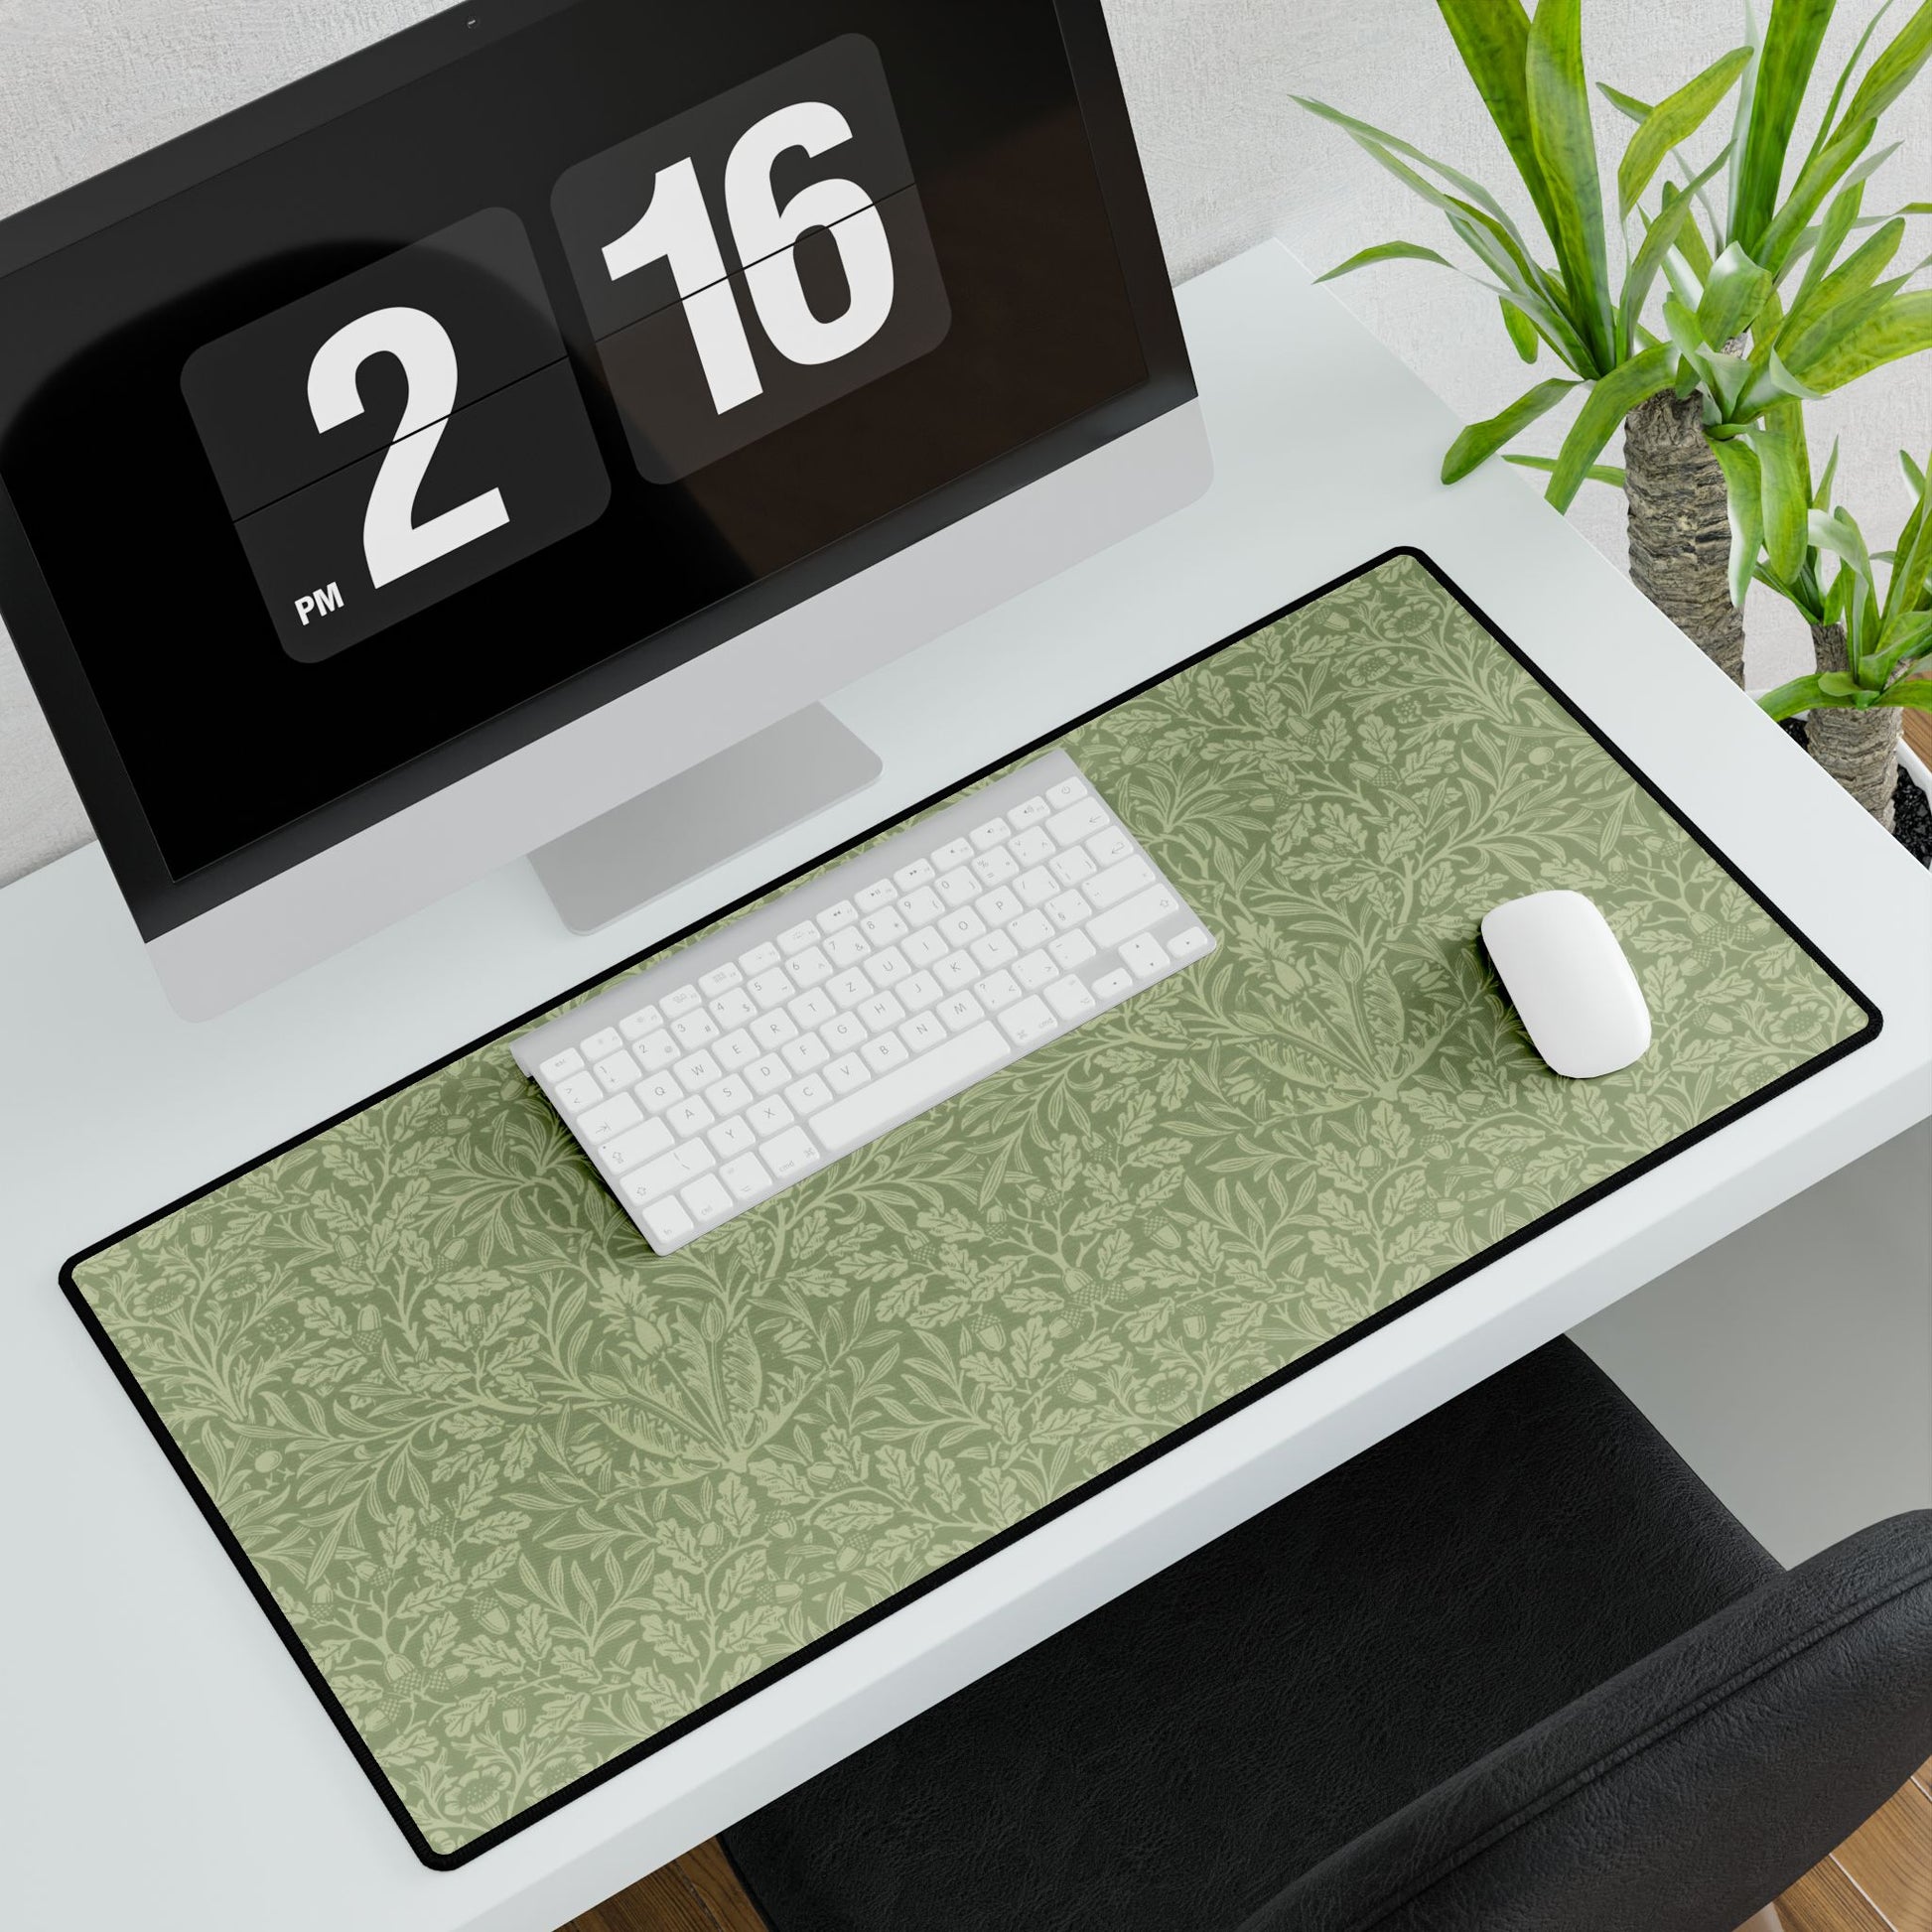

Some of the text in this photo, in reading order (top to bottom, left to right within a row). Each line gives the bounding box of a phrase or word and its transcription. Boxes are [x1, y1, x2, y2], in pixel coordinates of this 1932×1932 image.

[307, 101, 895, 590] 2 16
[294, 581, 345, 626] PM
[638, 1043, 648, 1054] 2
[676, 1023, 687, 1034] 3
[717, 1002, 725, 1012] 4
[754, 981, 762, 992] 5
[792, 961, 800, 971] 6
[828, 939, 836, 951] 7
[903, 900, 912, 910] 9
[940, 880, 950, 890] 0
[654, 1086, 666, 1097] Q
[690, 1063, 705, 1076] W
[731, 1043, 742, 1055] E
[769, 1024, 781, 1035] R
[807, 1002, 817, 1013] T
[845, 981, 857, 994] Z
[882, 960, 894, 973] U
[957, 920, 969, 931] O
[995, 900, 1004, 911] P
[684, 1108, 695, 1120] A
[722, 1087, 733, 1098] S
[759, 1065, 771, 1077] D
[798, 1044, 807, 1055] F
[836, 1024, 848, 1035] G
[873, 1003, 887, 1015] H
[913, 983, 922, 994] J
[949, 961, 962, 973] K
[987, 942, 999, 952] L
[724, 1128, 735, 1140] Y
[763, 1107, 776, 1120] X
[801, 1086, 814, 1097] C
[839, 1064, 850, 1076] V
[878, 1044, 890, 1056] B
[915, 1023, 928, 1035] N
[953, 1002, 967, 1016] M
